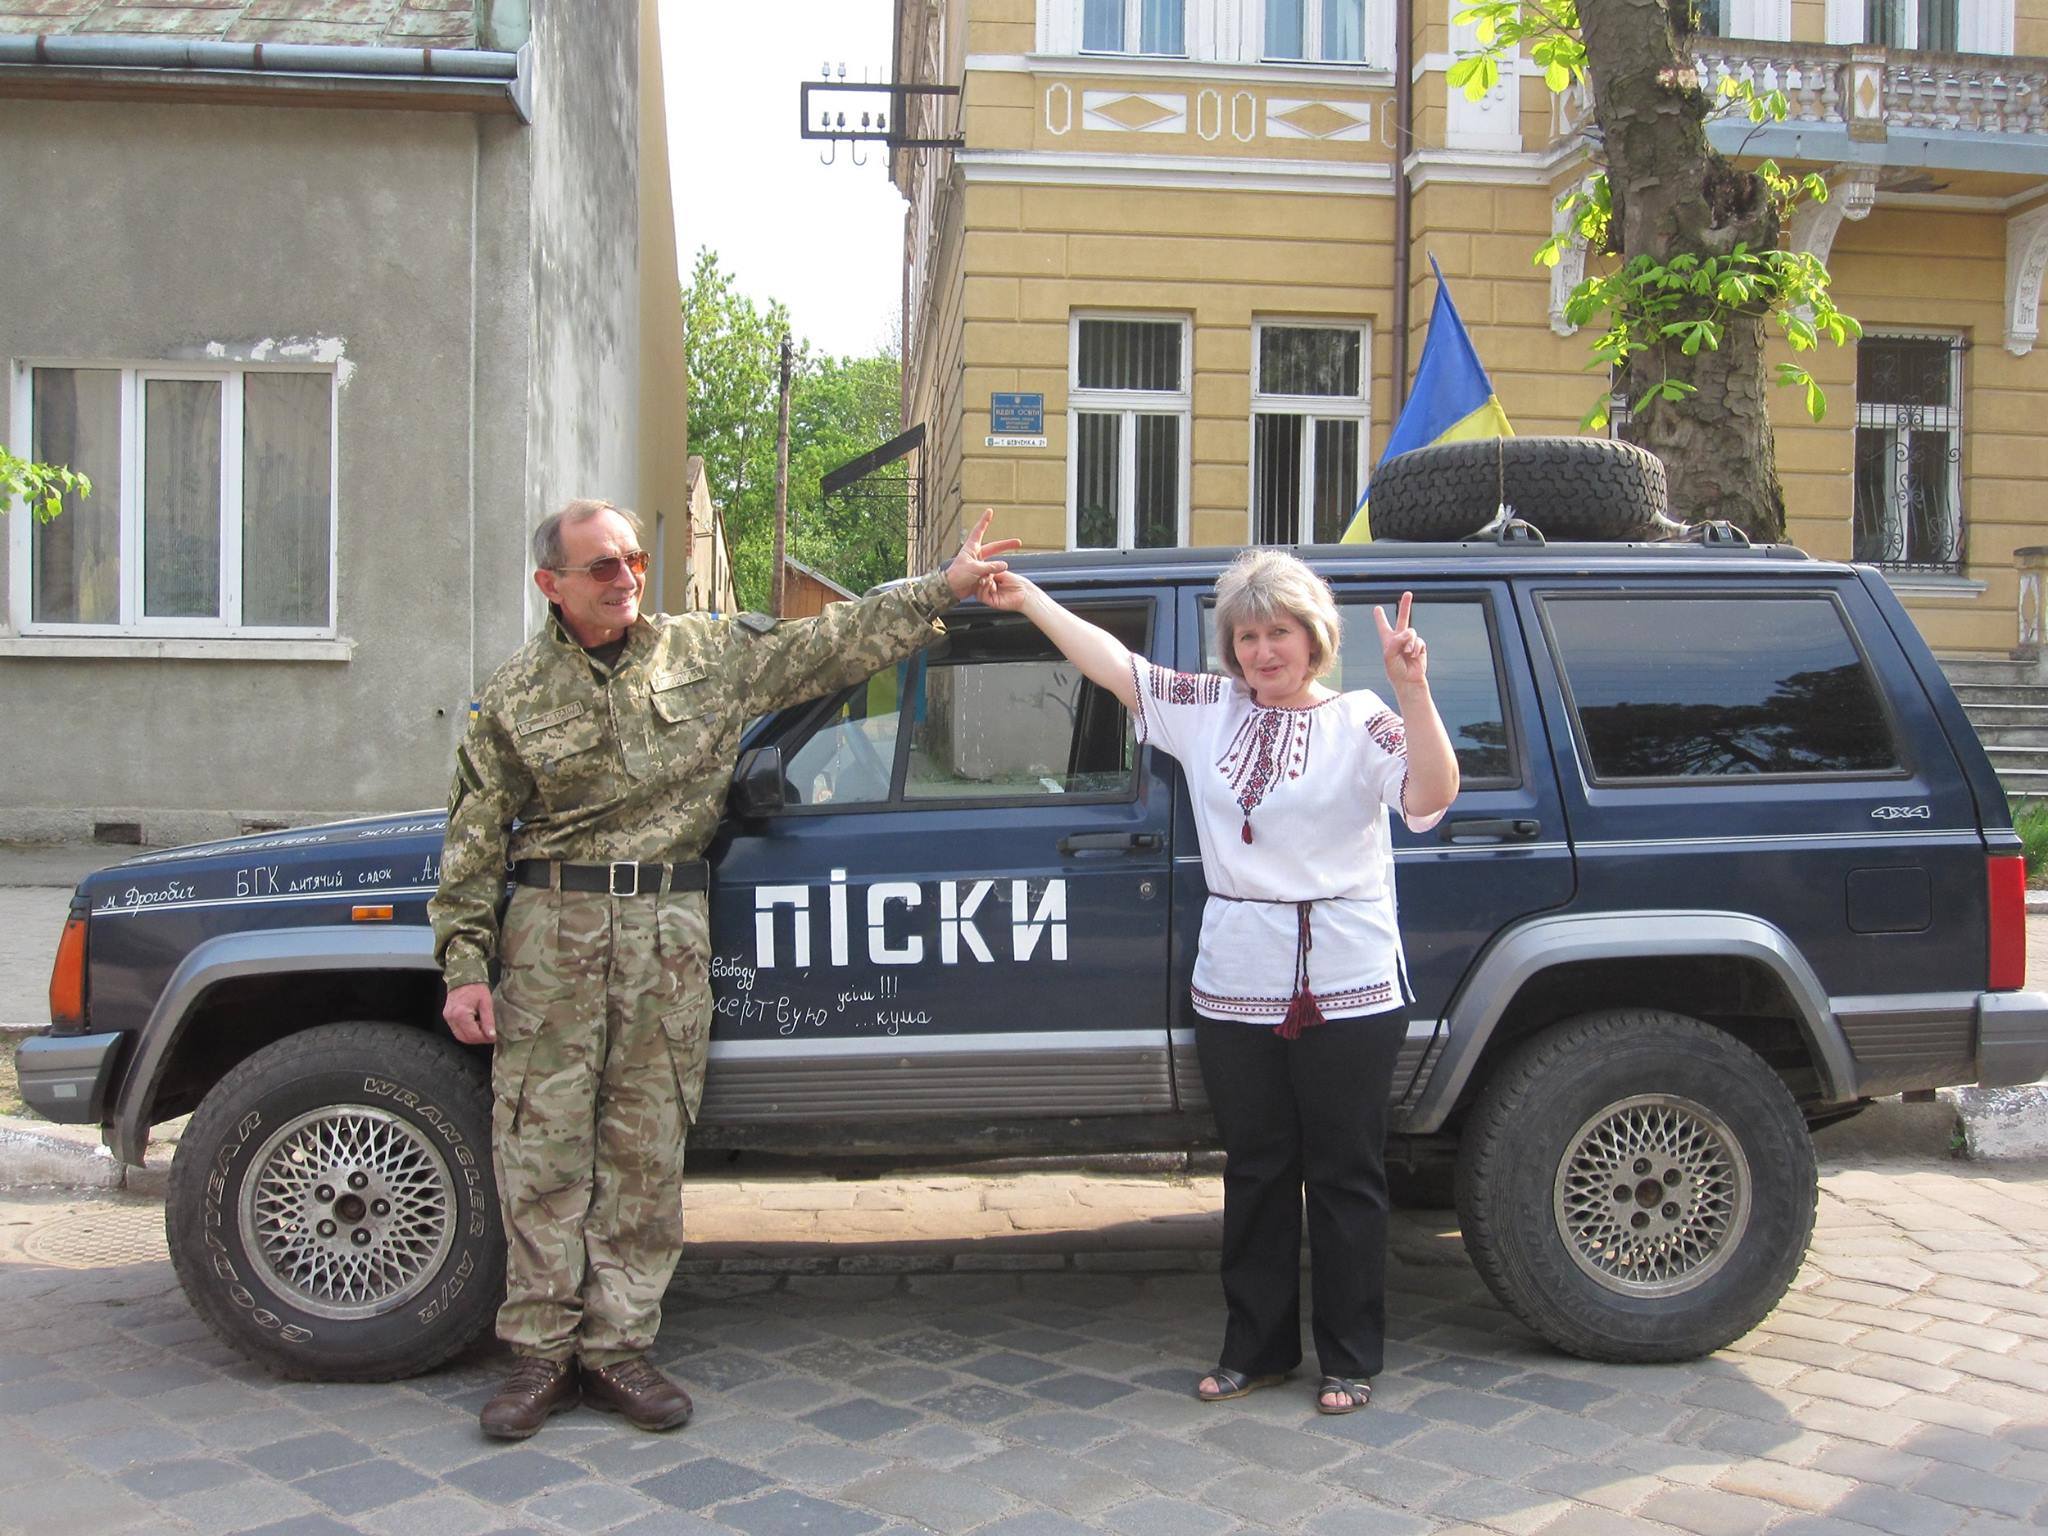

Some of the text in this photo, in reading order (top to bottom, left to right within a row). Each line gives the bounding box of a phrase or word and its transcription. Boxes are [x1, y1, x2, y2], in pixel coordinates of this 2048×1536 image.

[125, 881, 195, 918] Дрогобич
[236, 865, 280, 897] БГК
[363, 1077, 486, 1238] WRANGLER
[204, 1110, 314, 1343] GOODYEAR
